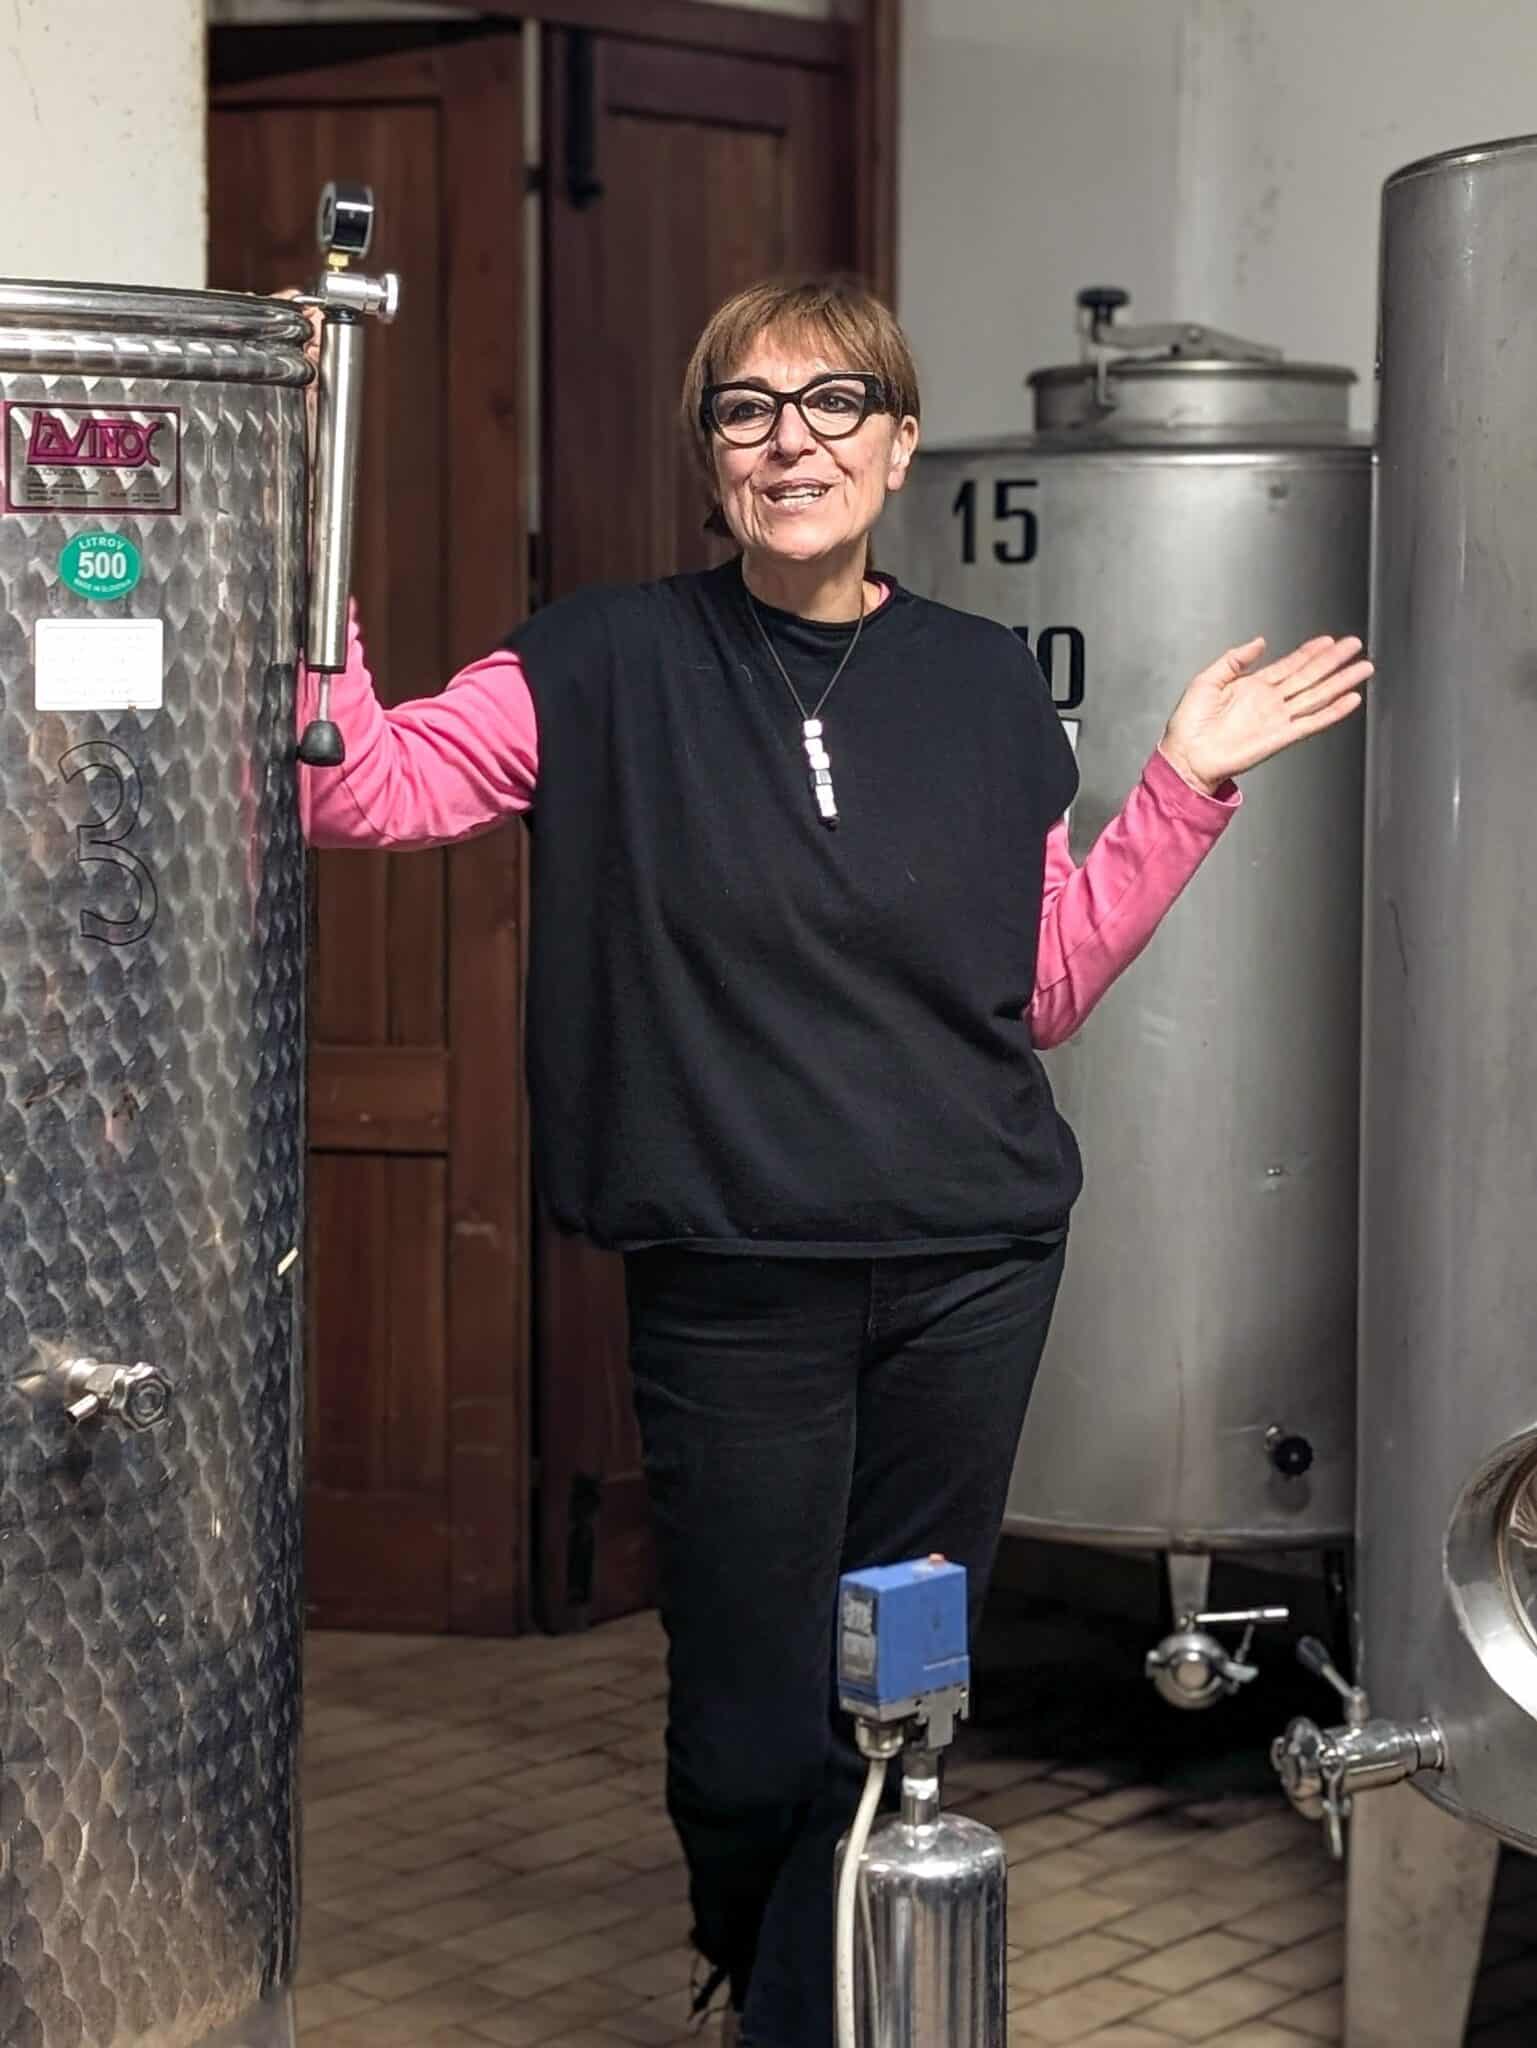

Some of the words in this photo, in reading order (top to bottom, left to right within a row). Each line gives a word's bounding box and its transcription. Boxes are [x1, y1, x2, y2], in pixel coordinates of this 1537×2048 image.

[953, 480, 1038, 564] 15
[78, 551, 127, 579] 500
[58, 741, 158, 945] 3
